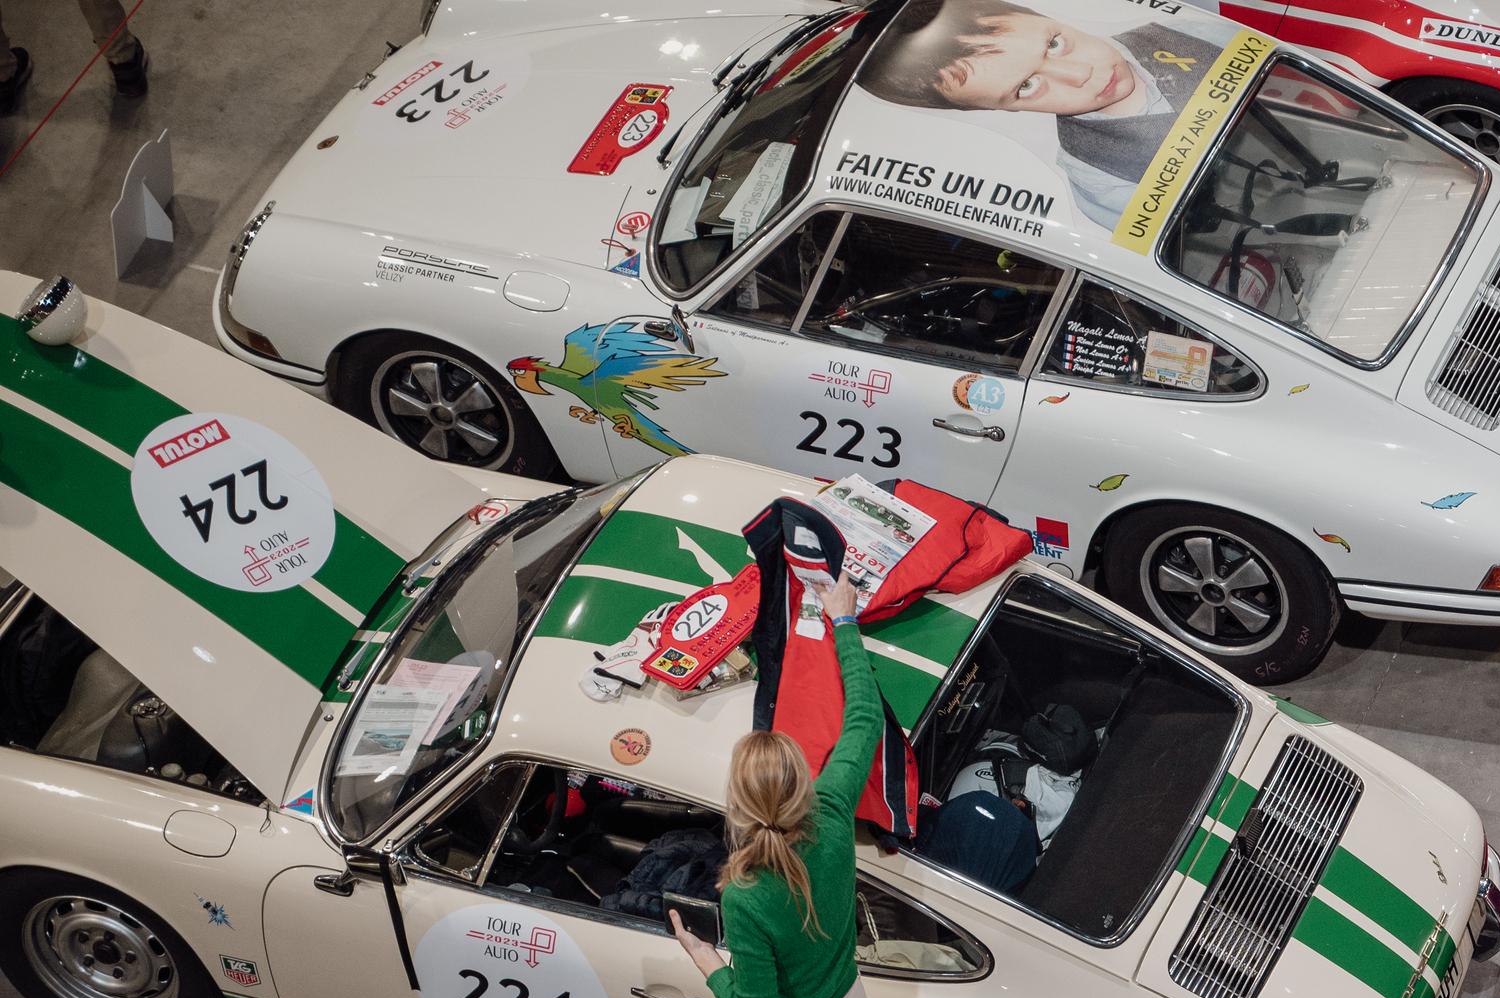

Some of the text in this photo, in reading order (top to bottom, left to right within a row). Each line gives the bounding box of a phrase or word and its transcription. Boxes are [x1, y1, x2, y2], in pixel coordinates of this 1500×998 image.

[376, 62, 437, 104] MOTUL
[395, 60, 490, 123] 223
[621, 112, 656, 142] 223
[1129, 214, 1152, 238] UN
[1143, 158, 1184, 213] CANCER
[1208, 41, 1264, 103] SÉRIEUX
[836, 151, 1055, 218] FAITES UN DON
[829, 175, 1044, 237] WWW.CANCERDELENFANT.FR
[382, 246, 489, 273] PORSCHE
[377, 260, 455, 282] CLASSIC PARTNER
[1067, 321, 1103, 337] Magali
[1104, 330, 1135, 343] Lemos
[828, 359, 860, 378] TOUR
[825, 376, 857, 388] 2023
[824, 386, 857, 403] AUTO
[971, 385, 1000, 404] A3
[154, 422, 222, 464] MOTUL
[796, 410, 902, 468] 223
[179, 459, 289, 543] 224
[259, 530, 289, 551] AUTO
[269, 544, 296, 561] 2023
[276, 553, 308, 574] TOUR
[674, 600, 722, 639] 224
[487, 916, 522, 937] TOUR
[484, 933, 519, 947] 2023
[484, 945, 519, 963] AUTO
[226, 969, 258, 985] HEUER
[227, 959, 251, 973] TAG
